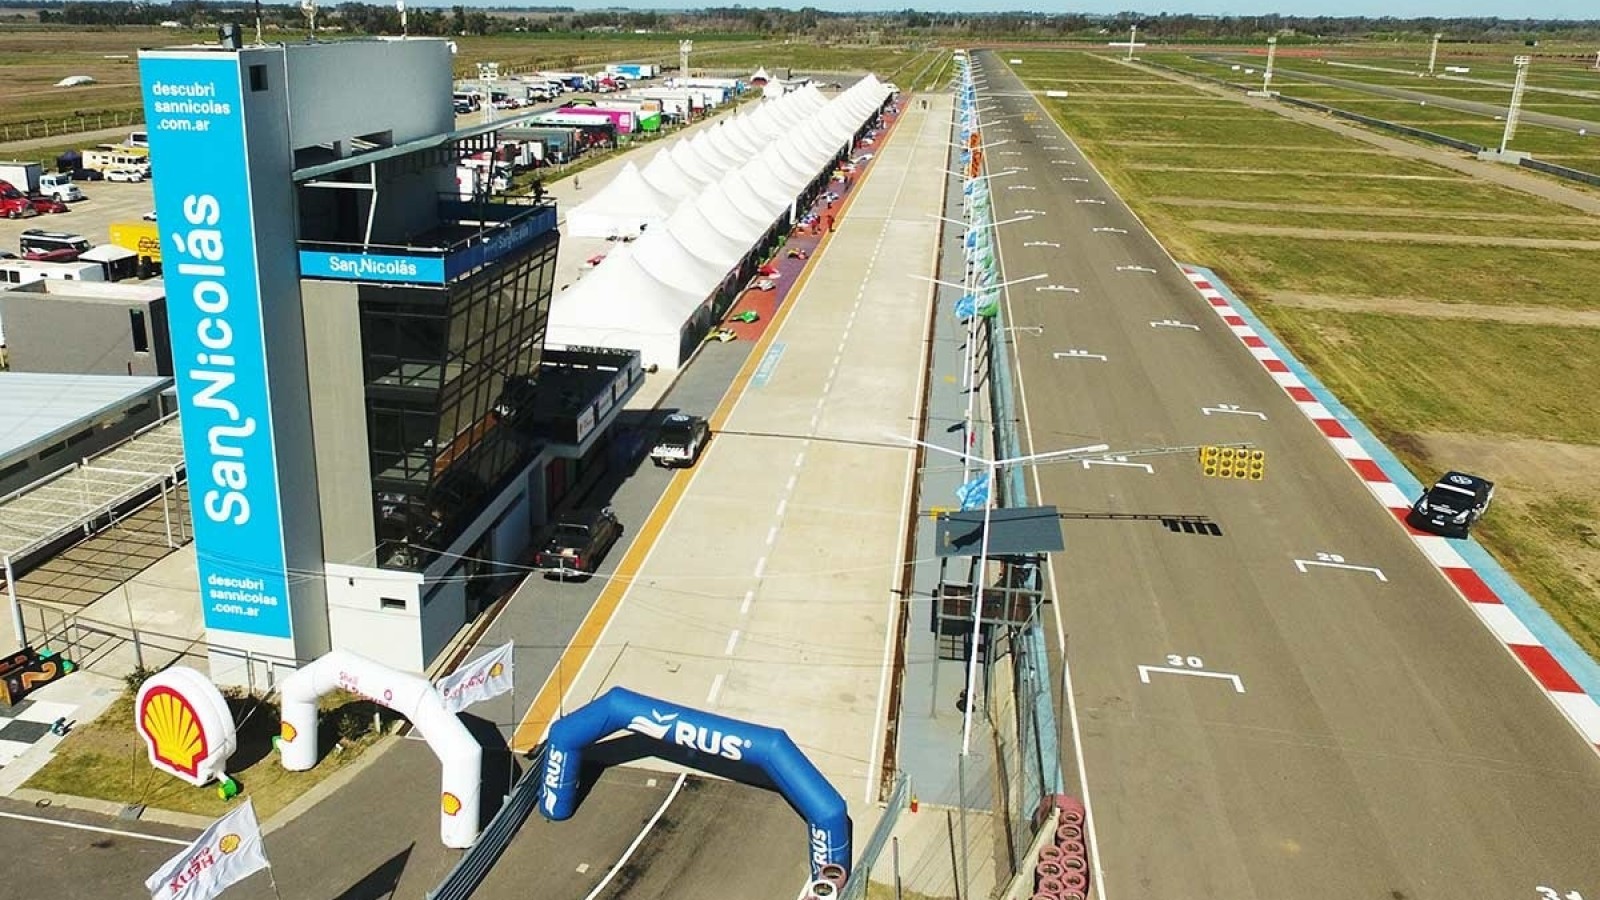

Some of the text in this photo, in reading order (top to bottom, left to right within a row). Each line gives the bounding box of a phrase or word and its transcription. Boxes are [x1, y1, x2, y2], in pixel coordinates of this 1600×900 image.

[152, 81, 216, 98] descubri
[154, 100, 231, 115] sannicolas
[157, 118, 210, 132] .com.ar
[329, 256, 417, 277] San Nicolás
[171, 193, 257, 525] San Nicolás
[207, 573, 265, 591] descubri
[209, 588, 278, 606] sannicolas
[211, 603, 260, 617] .com.ar
[1167, 654, 1204, 669] 30
[675, 720, 744, 761] RUS
[545, 748, 563, 789] RUS
[811, 827, 828, 865] RUS
